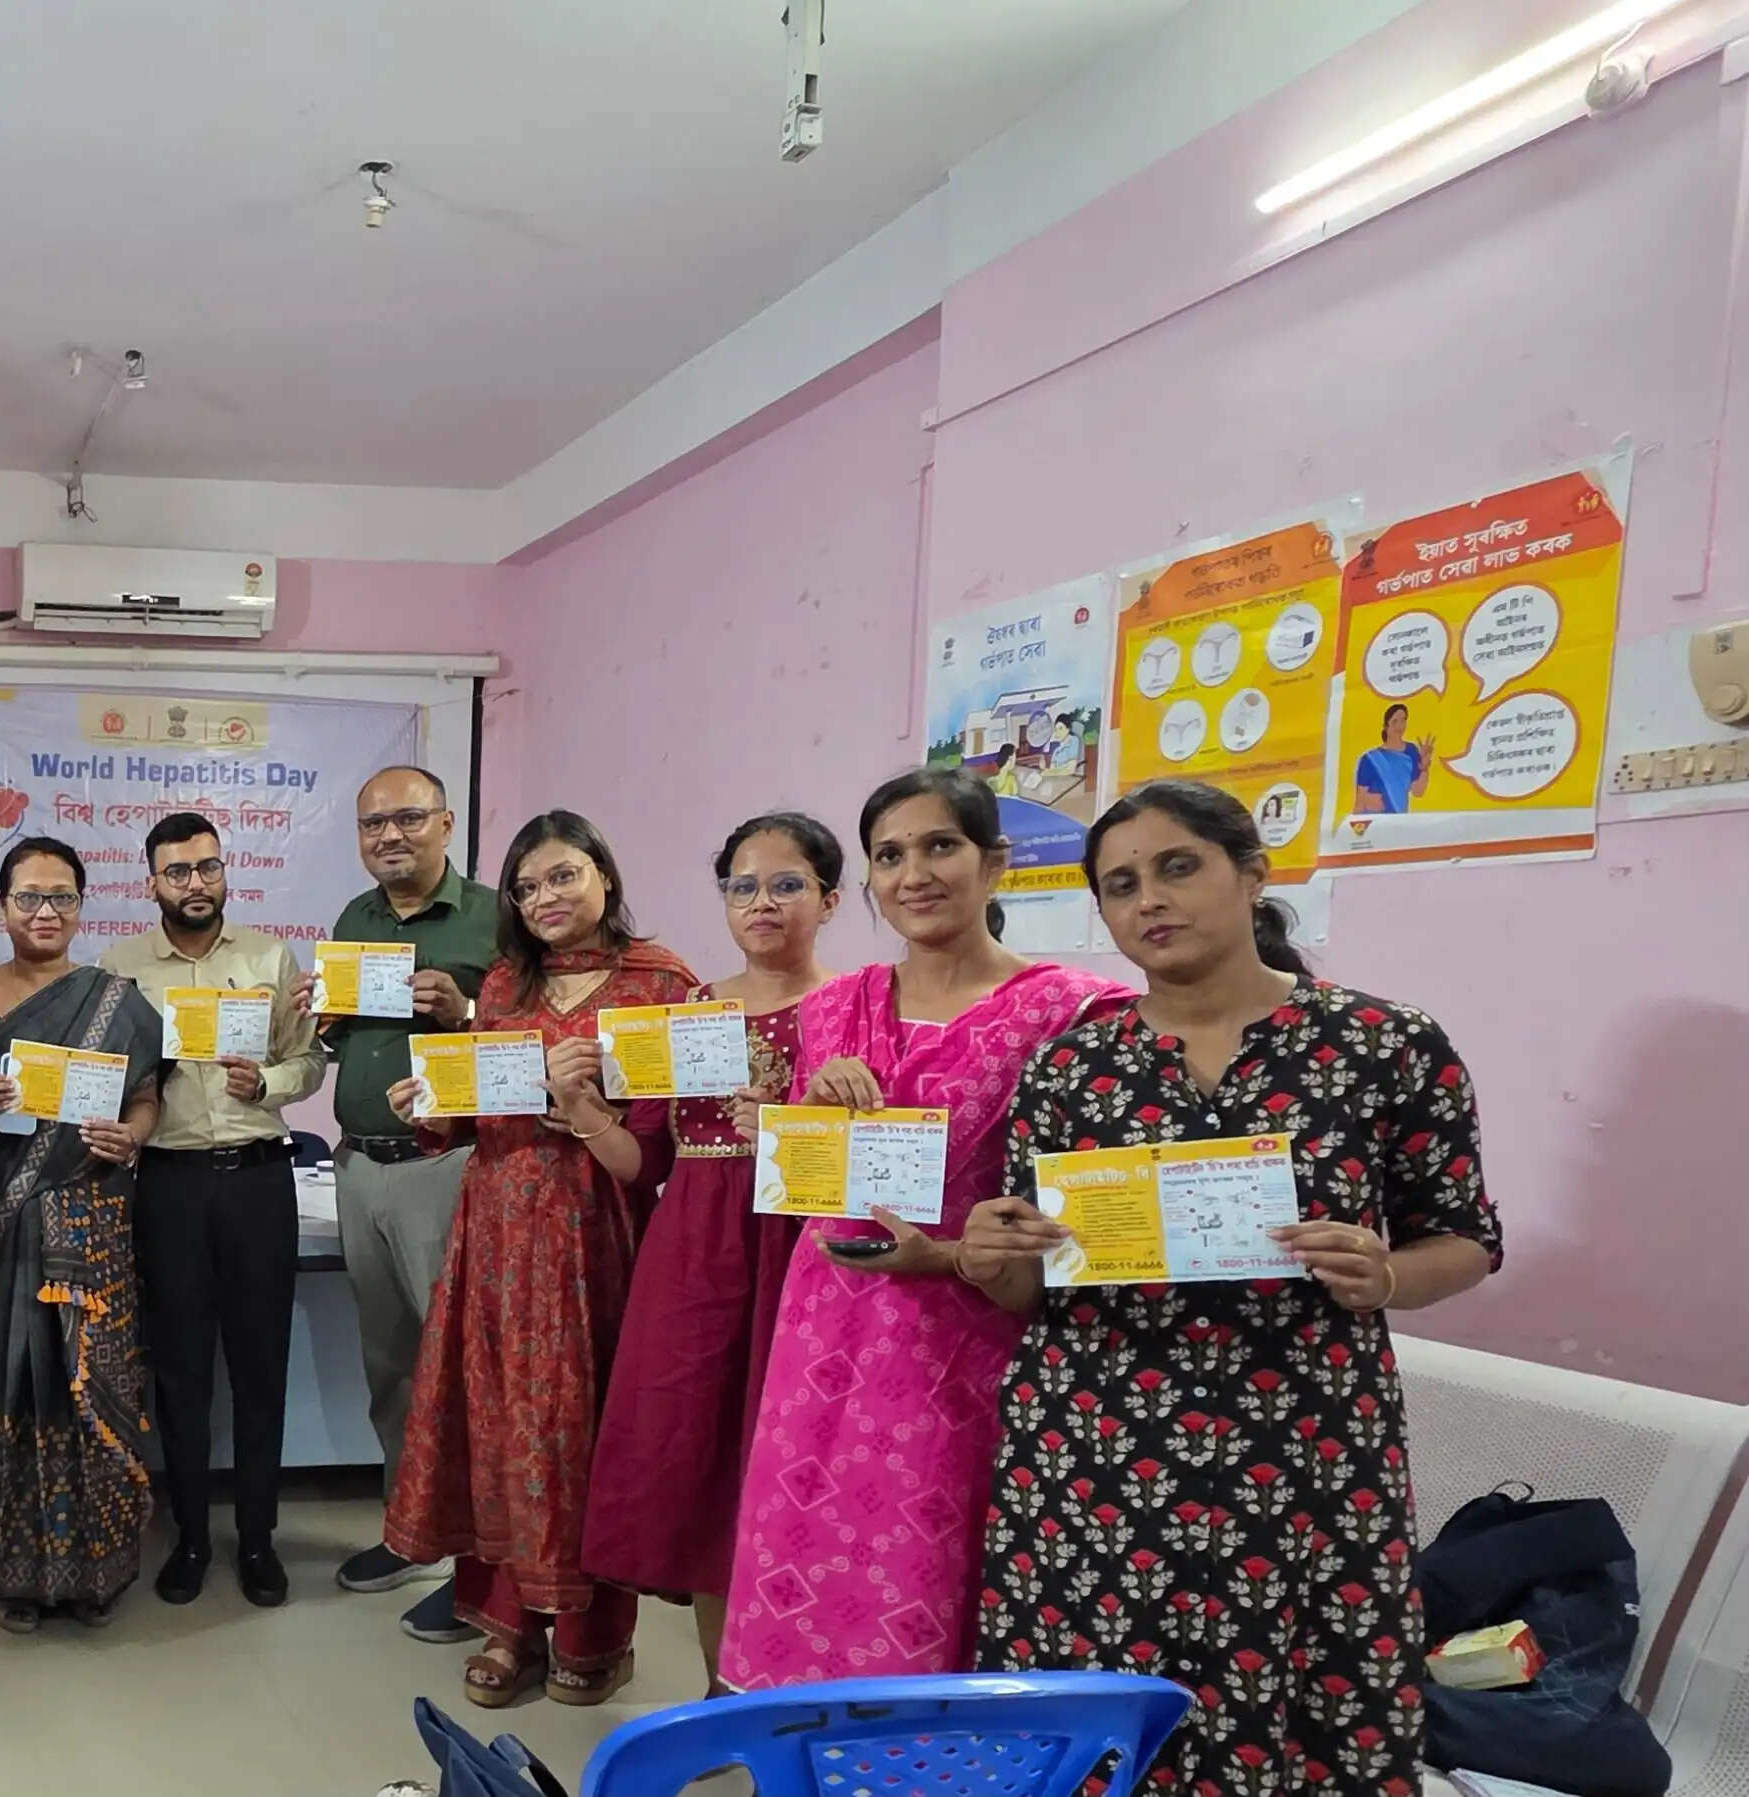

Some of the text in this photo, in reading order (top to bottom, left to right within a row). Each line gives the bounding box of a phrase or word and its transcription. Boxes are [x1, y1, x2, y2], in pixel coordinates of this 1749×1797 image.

[31, 753, 318, 793] World Hepatitis Day
[78, 848, 133, 864] patitis:
[240, 851, 285, 869] Down
